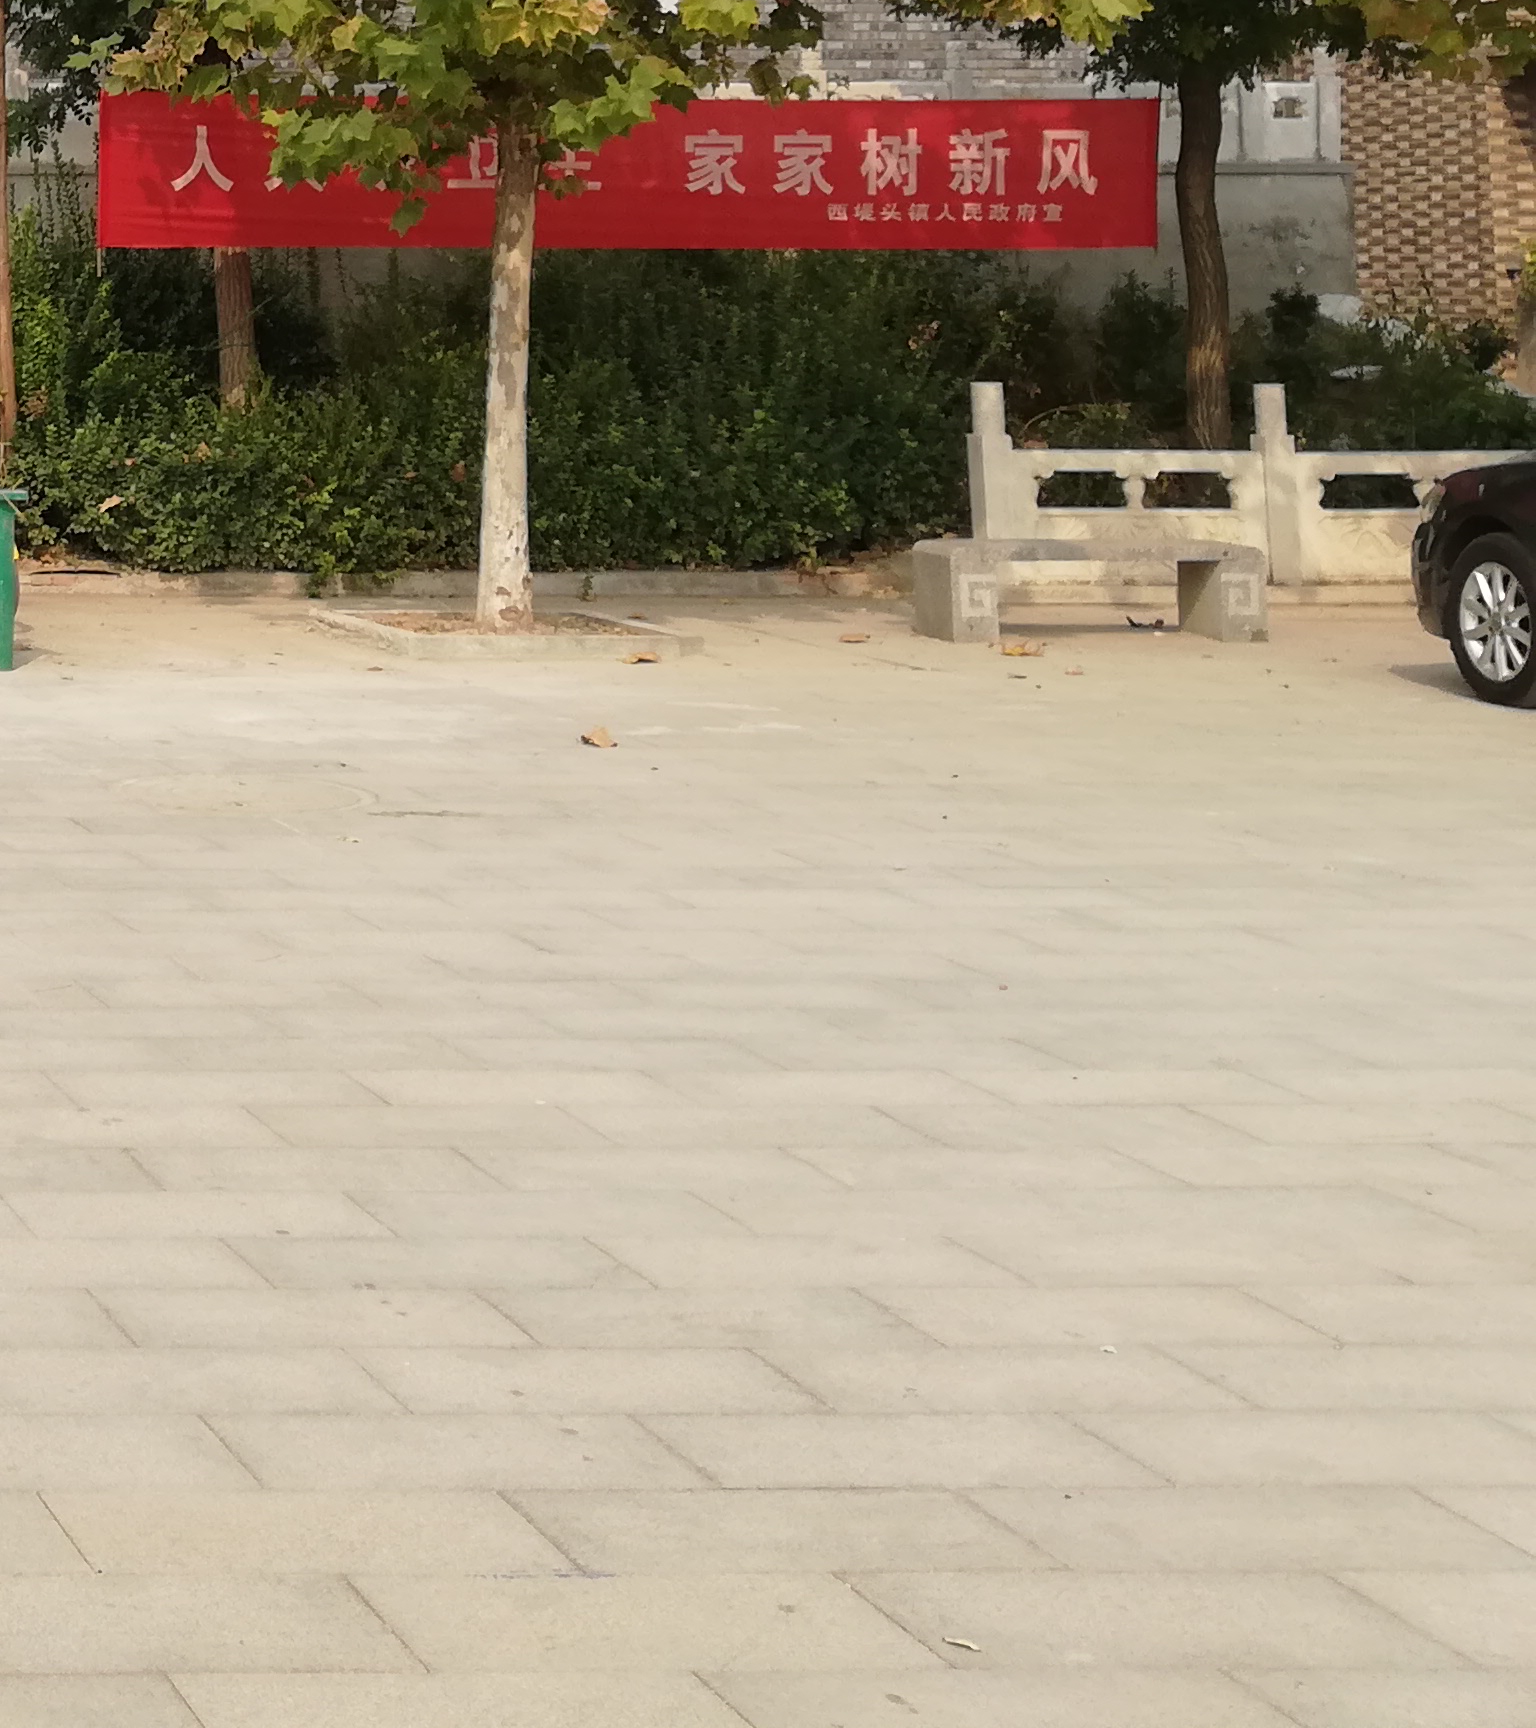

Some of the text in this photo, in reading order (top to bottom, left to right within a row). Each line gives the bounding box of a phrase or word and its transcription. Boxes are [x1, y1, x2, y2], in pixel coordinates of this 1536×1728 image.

[684, 127, 1099, 197] 家家树新风
[826, 201, 1064, 223] 西堤头镇人民政府宣
